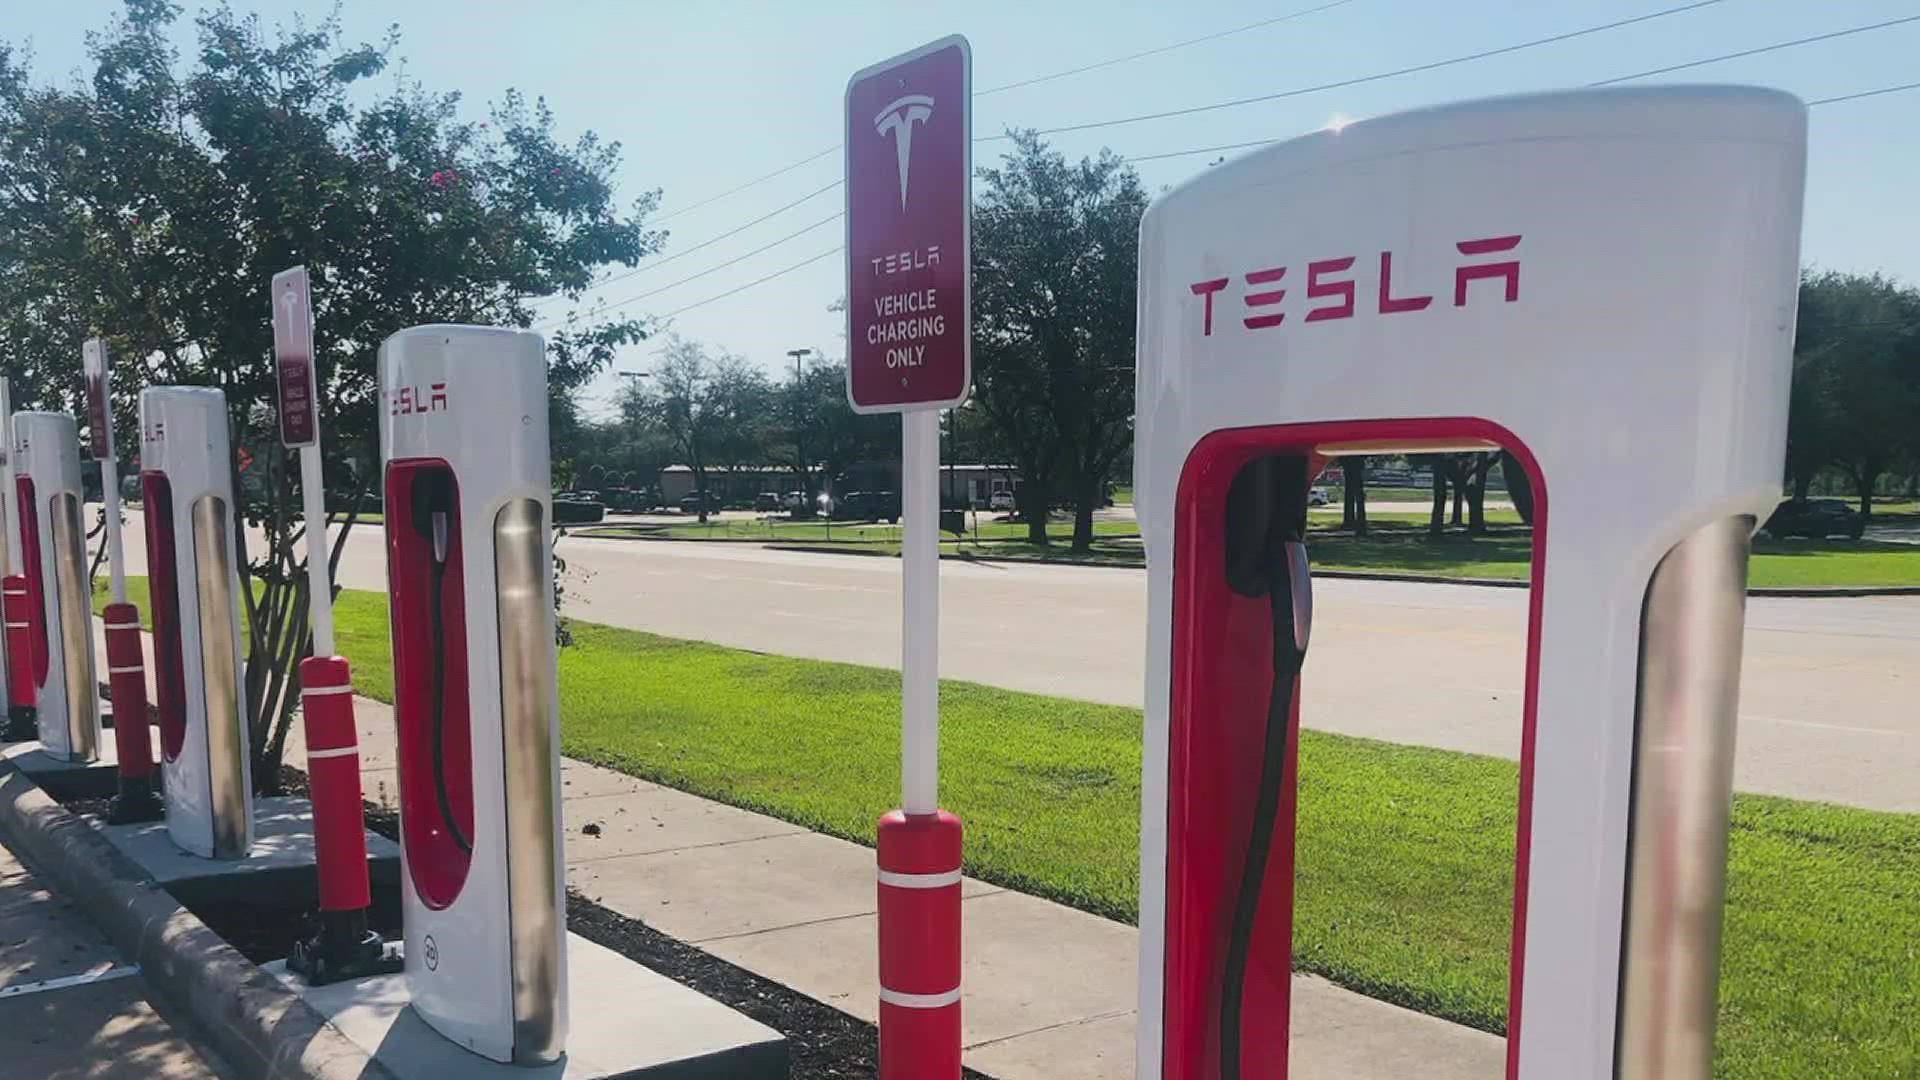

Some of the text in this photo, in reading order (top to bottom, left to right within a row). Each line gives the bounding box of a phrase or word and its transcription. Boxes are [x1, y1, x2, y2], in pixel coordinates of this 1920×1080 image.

[872, 245, 939, 275] TESLA
[1191, 235, 1522, 336] TESLA
[874, 289, 936, 317] VEHICLE
[867, 315, 945, 344] CHARGING
[886, 345, 925, 368] ONLY
[383, 383, 446, 416] ESLA
